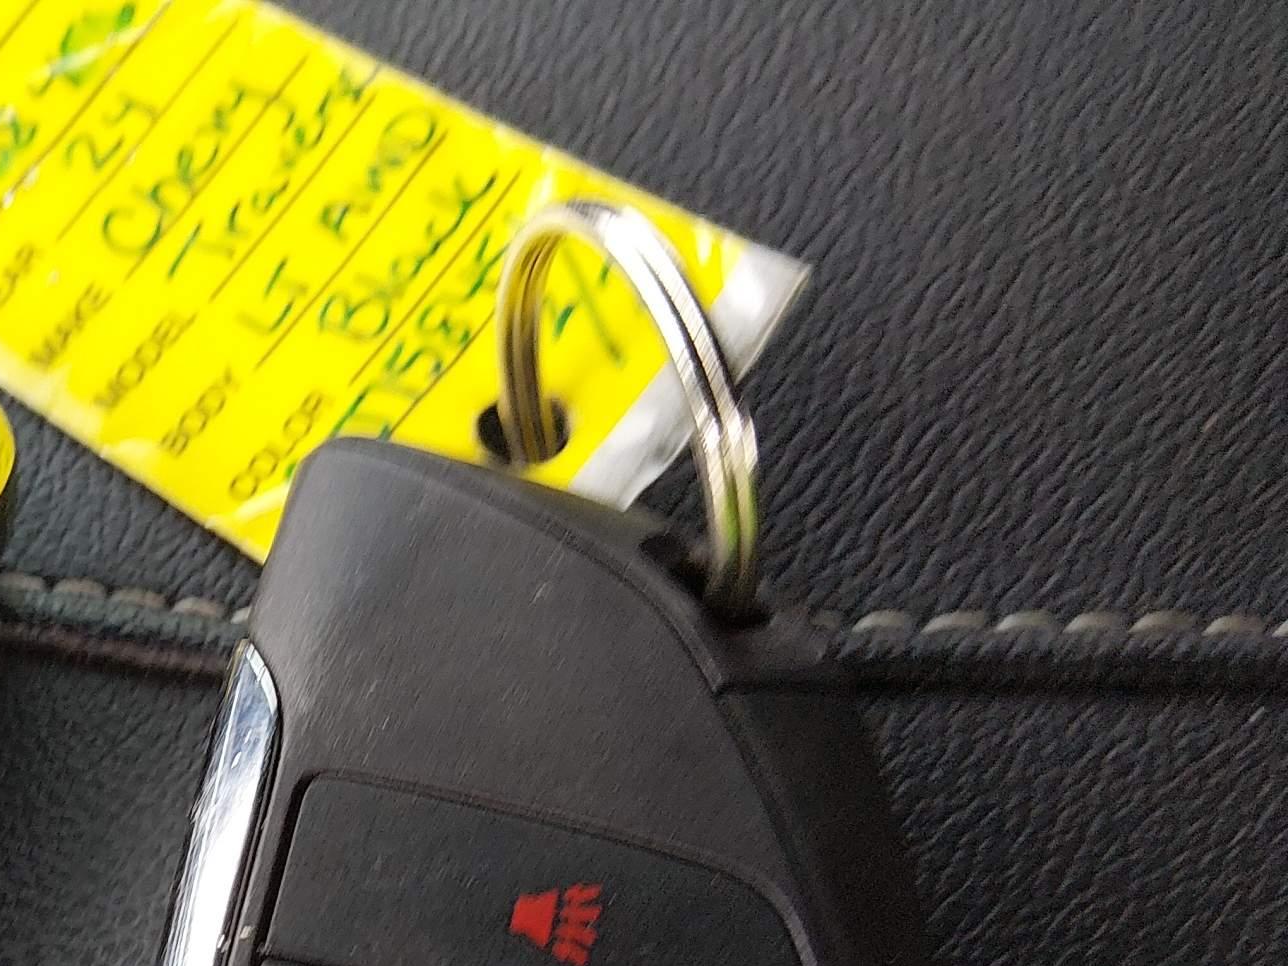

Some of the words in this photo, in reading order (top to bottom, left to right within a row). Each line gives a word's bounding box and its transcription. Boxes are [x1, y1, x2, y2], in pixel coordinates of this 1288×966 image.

[64, 94, 159, 173] 24
[318, 168, 498, 342] Black
[29, 281, 114, 372] MAKE
[92, 312, 197, 412] MODEL
[161, 366, 239, 458] BODY
[229, 389, 334, 502] COLOR
